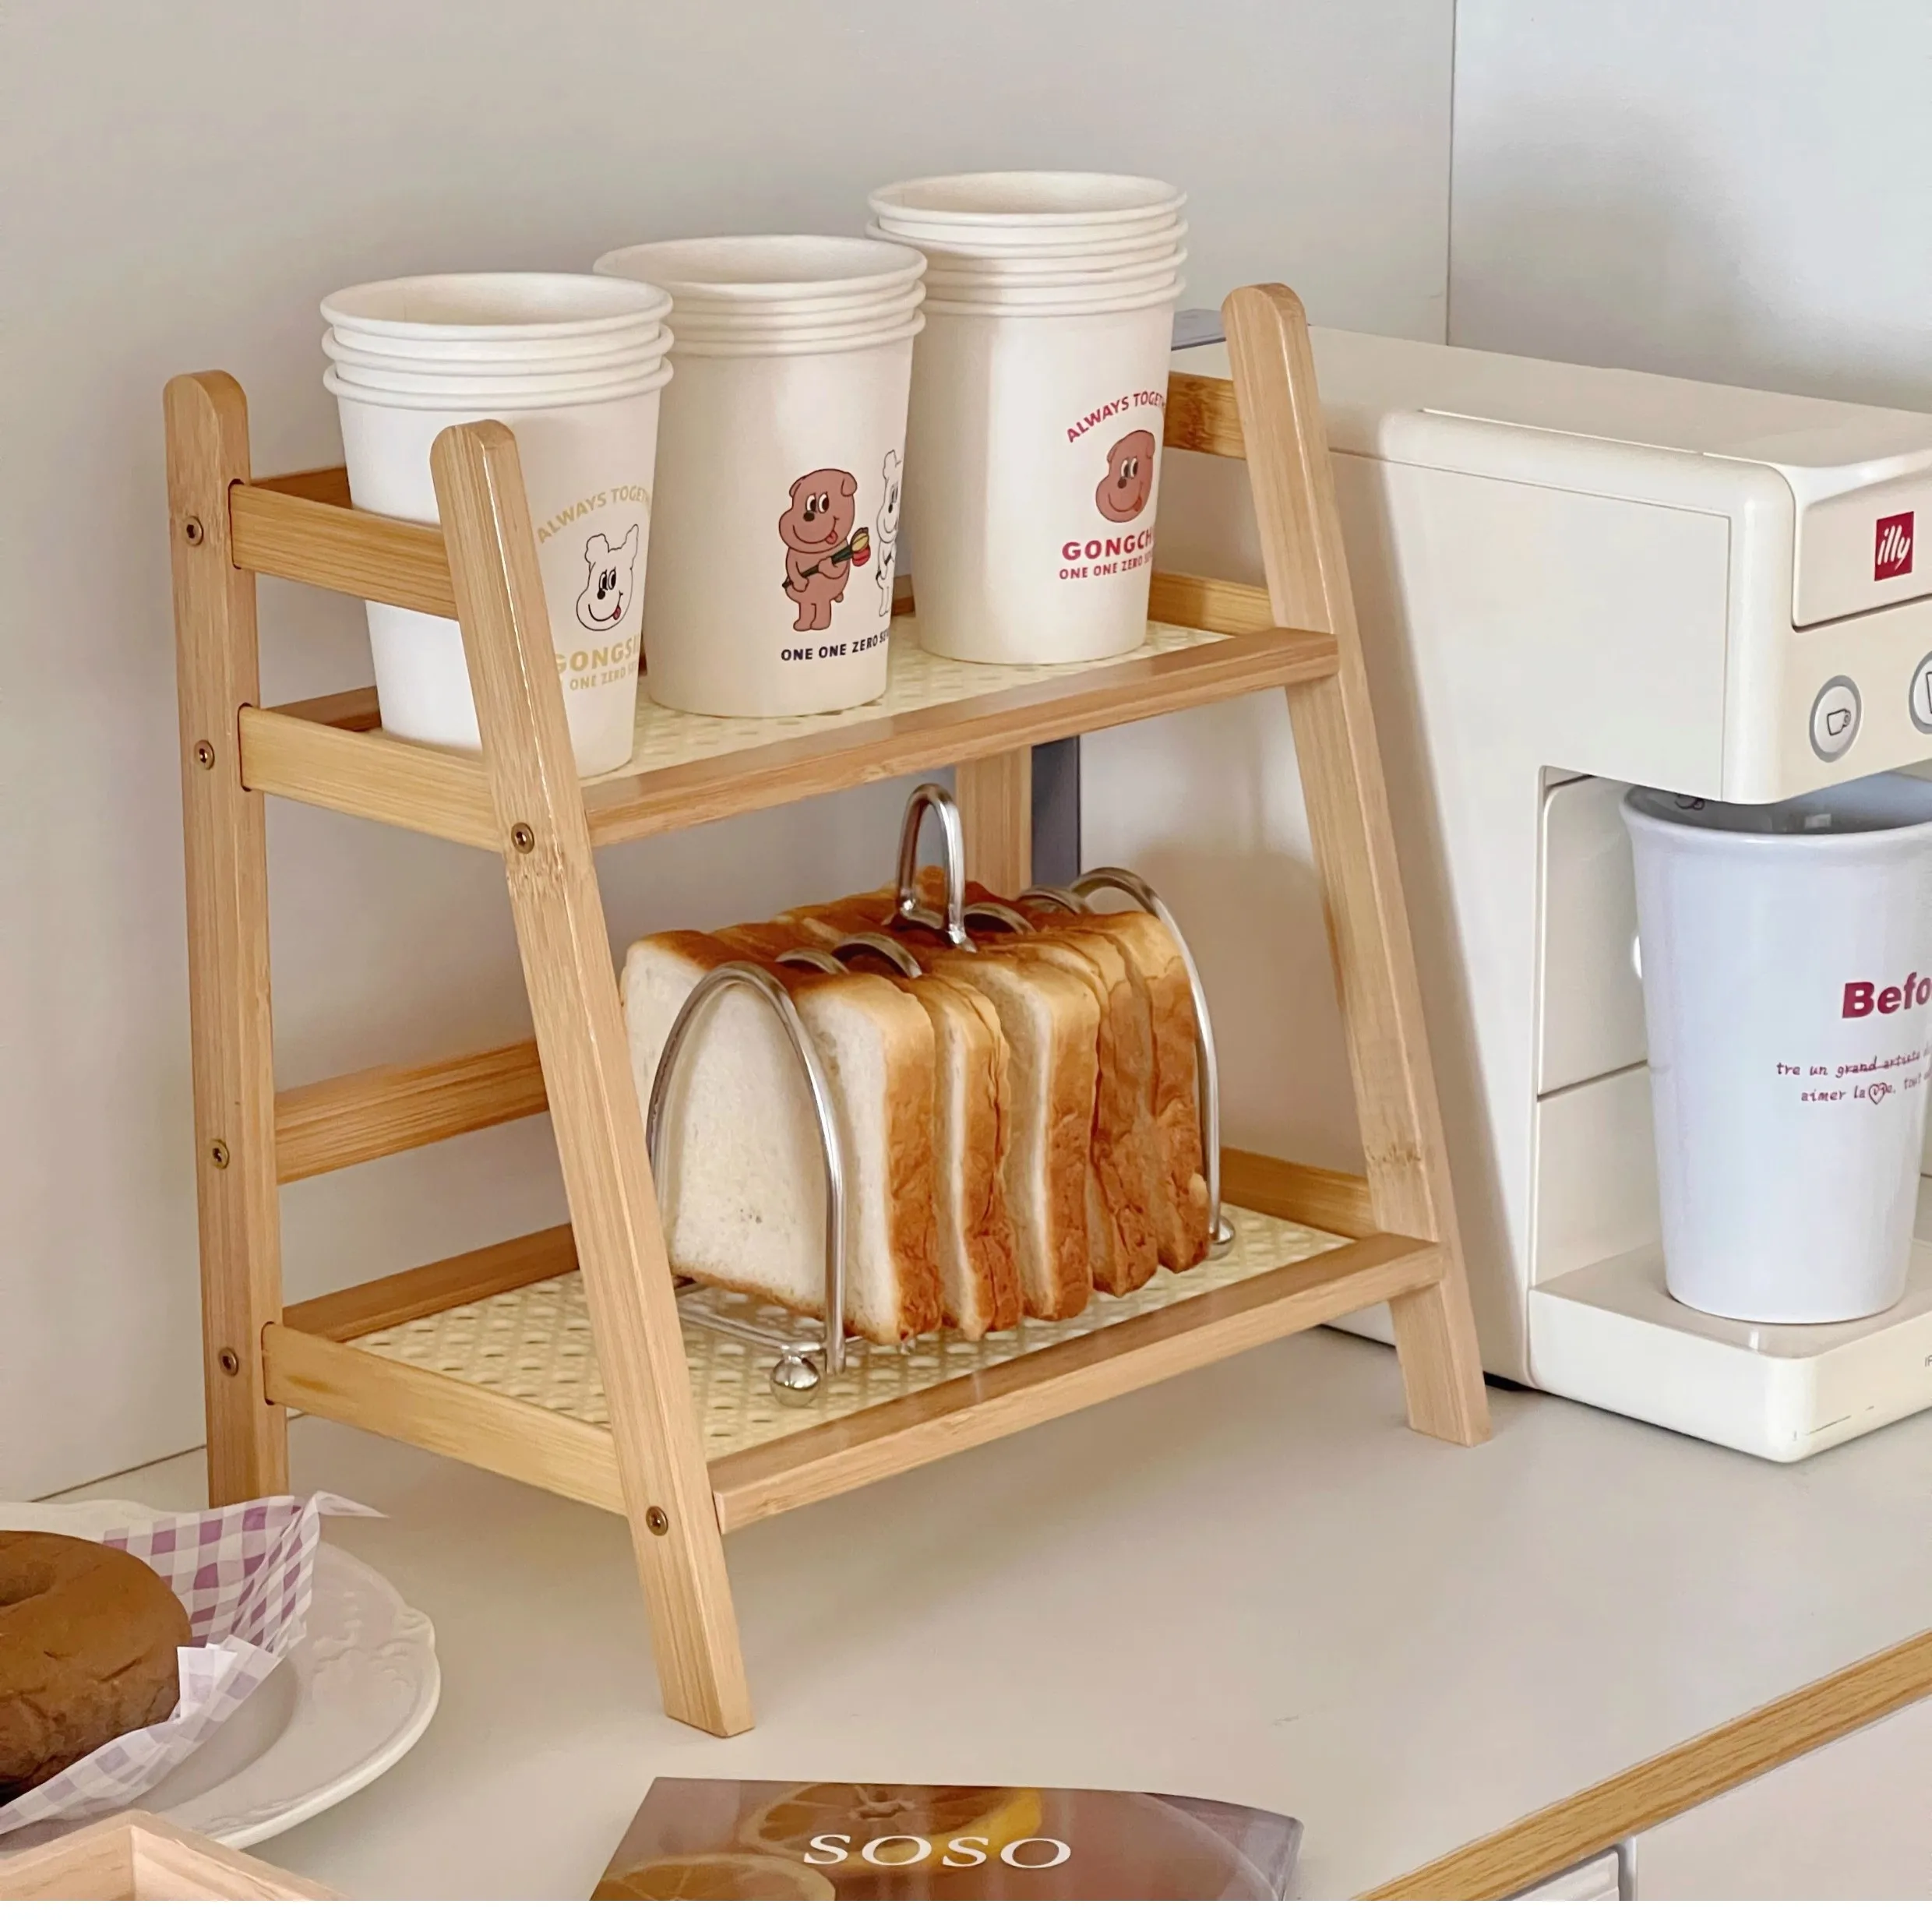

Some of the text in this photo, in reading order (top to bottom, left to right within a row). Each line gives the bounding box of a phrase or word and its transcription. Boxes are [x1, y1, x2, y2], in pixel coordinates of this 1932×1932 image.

[1066, 396, 1129, 442] ALWAYS
[537, 492, 607, 544] ALWAYS
[1877, 524, 1911, 570] illy
[1059, 566, 1088, 580] ONE
[1093, 562, 1117, 576] ONE
[1121, 555, 1143, 572] ZERO
[781, 648, 813, 661] ONE
[818, 643, 847, 658] ONE
[851, 634, 879, 654] ZERO
[569, 675, 597, 691] ONE
[601, 666, 626, 685] ZERO
[1776, 1062, 1800, 1075] tre
[1810, 1065, 1828, 1076] un
[1835, 1055, 1877, 1078] grand
[1801, 1089, 1846, 1102] aimer
[1854, 1085, 1866, 1099] la
[803, 1833, 1072, 1869] SOSO
